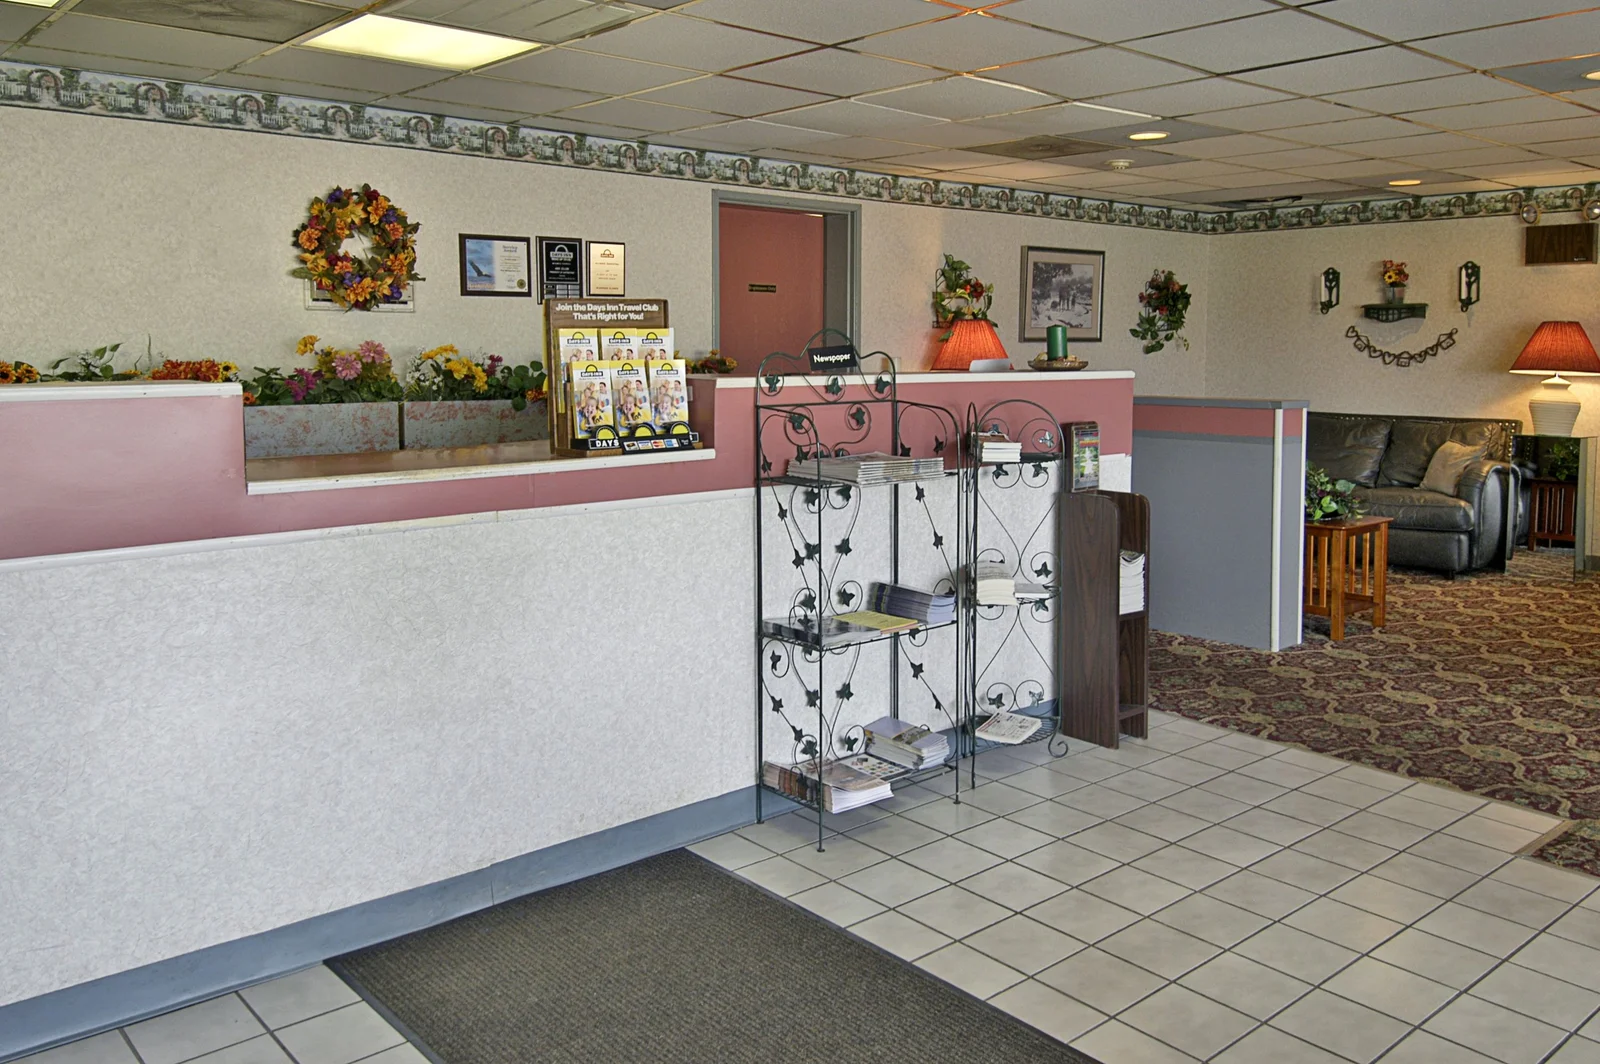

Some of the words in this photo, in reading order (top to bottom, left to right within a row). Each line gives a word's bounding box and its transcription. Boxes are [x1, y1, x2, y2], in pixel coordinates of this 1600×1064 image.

[555, 303, 573, 311] Join
[573, 303, 587, 311] the
[587, 303, 606, 313] Days
[606, 303, 619, 311] Inn
[619, 303, 642, 311] Travel
[642, 303, 659, 312] Club
[573, 312, 597, 320] That's
[597, 312, 618, 322] Right
[617, 312, 629, 320] for
[628, 312, 644, 320] You!
[813, 354, 851, 363] Newspaper
[595, 439, 620, 448] DAYS
